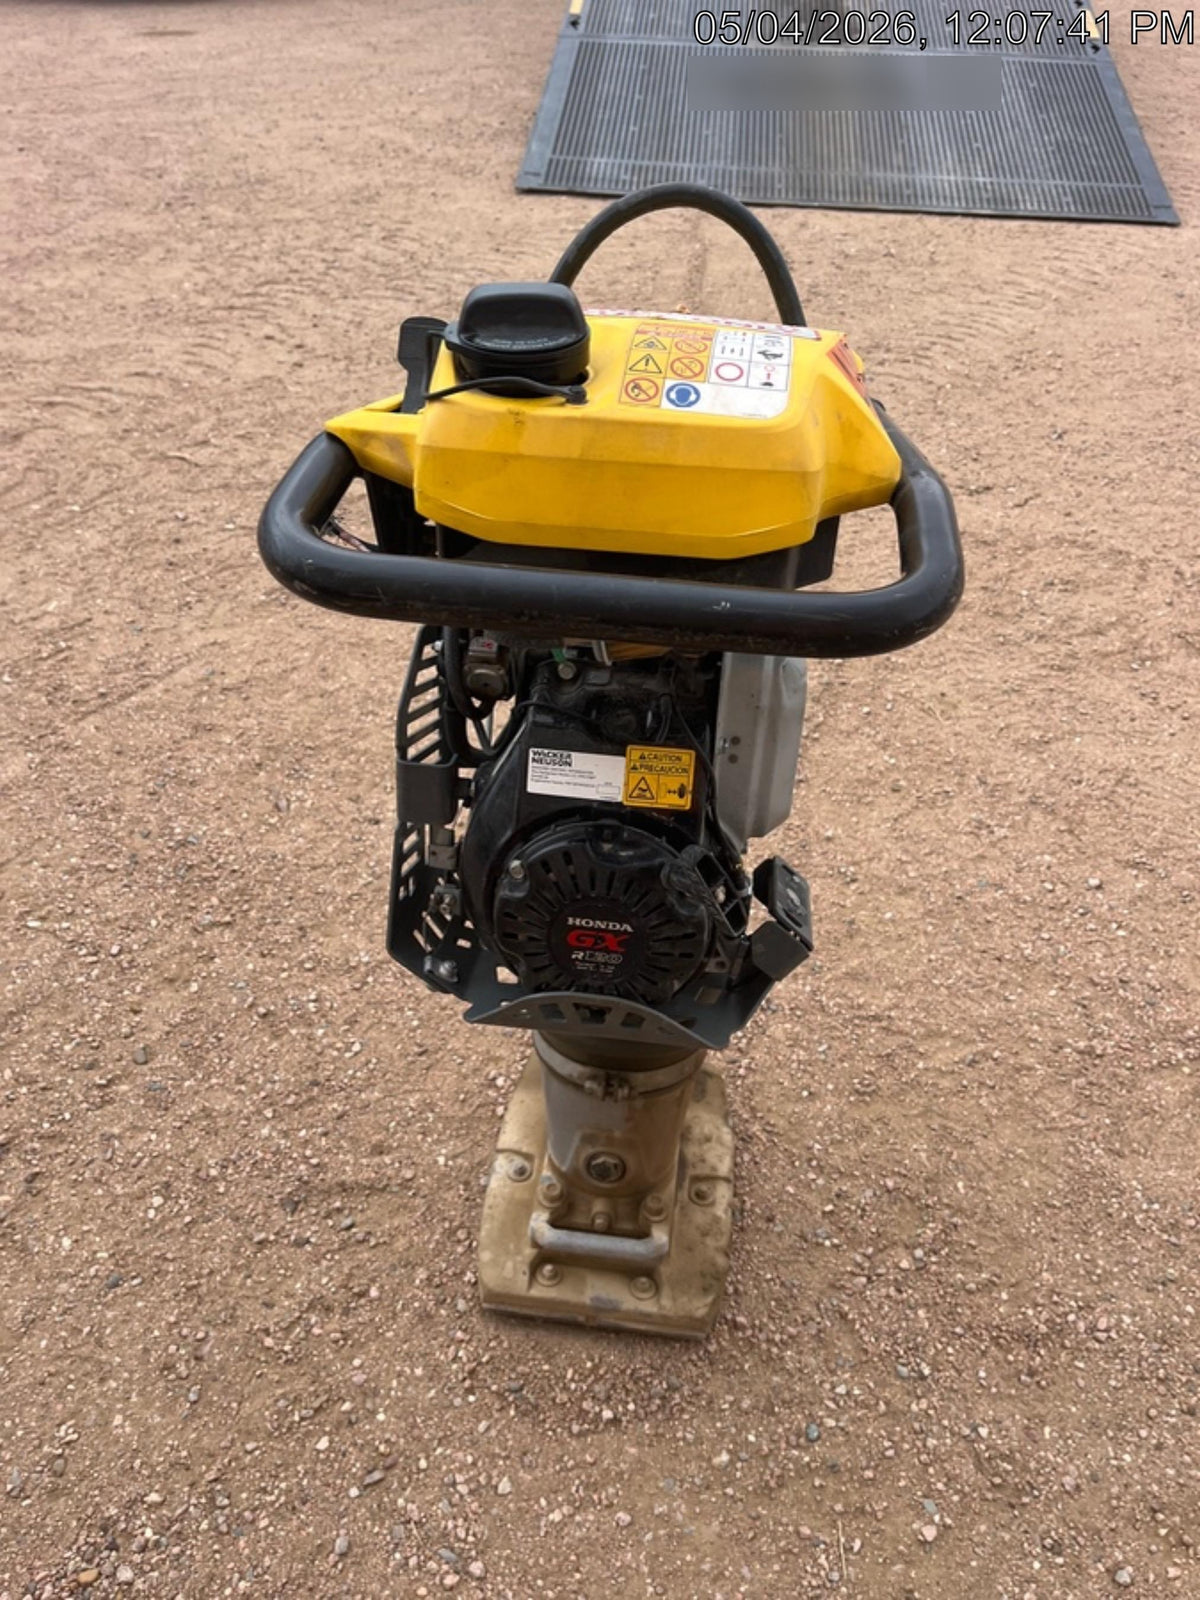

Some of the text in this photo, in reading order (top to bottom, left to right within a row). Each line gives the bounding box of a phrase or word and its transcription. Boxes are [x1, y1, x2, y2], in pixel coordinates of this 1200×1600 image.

[531, 750, 572, 760] WACKER
[646, 754, 683, 763] CAUTION
[531, 757, 573, 767] NEUSON
[567, 917, 634, 932] HONDA
[567, 930, 631, 952] GX
